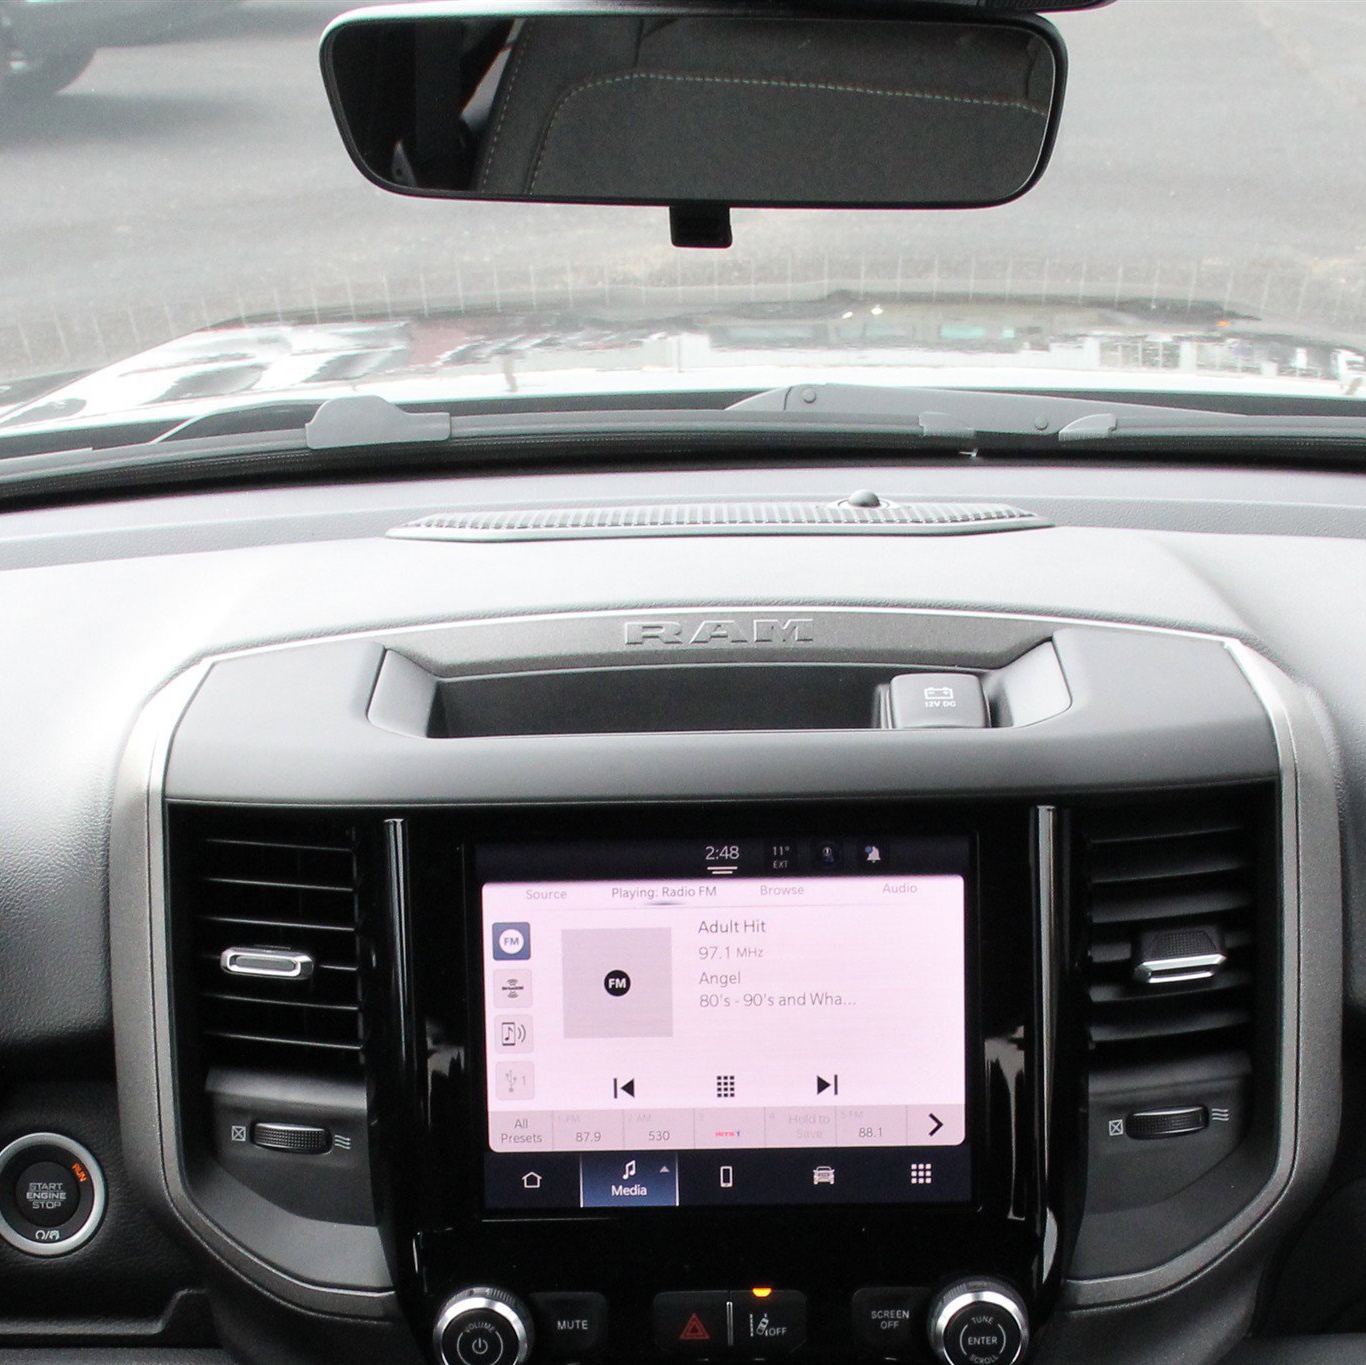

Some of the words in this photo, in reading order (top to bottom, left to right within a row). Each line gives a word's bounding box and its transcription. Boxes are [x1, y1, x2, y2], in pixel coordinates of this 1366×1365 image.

[624, 618, 814, 644] RAM
[705, 845, 740, 860] 2:48
[773, 860, 788, 869] EXT
[526, 889, 567, 900] Source
[611, 887, 658, 900] Playing:
[662, 886, 695, 897] Radio
[699, 886, 717, 896] FM
[760, 885, 804, 896] Browse
[882, 882, 918, 894] Audio
[697, 920, 739, 934] Adult
[744, 919, 766, 933] Hit
[503, 937, 519, 946] FM
[698, 946, 731, 960] 97.1
[736, 947, 764, 958] MHz
[608, 978, 627, 989] FM
[699, 971, 741, 988] Angel
[699, 994, 731, 1007] 80's
[743, 993, 775, 1007] 90's
[779, 992, 806, 1006] and
[514, 1119, 528, 1129] All
[500, 1132, 542, 1144] Presets
[576, 1131, 602, 1142] 87.9
[648, 1130, 670, 1141] 530
[858, 1127, 883, 1138] 88.1
[71, 1162, 87, 1183] RUN
[28, 1182, 63, 1191] START
[611, 1184, 648, 1196] Media
[26, 1192, 67, 1200] ENGINE
[32, 1201, 62, 1209] STOP
[871, 1310, 910, 1319] SCREEN
[557, 1320, 588, 1330] MUTE
[881, 1321, 899, 1330] OFF
[972, 1316, 994, 1325] TUNE
[464, 1321, 495, 1333] VOLUME
[769, 1327, 787, 1337] OFF
[968, 1336, 998, 1345] ENTER
[969, 1353, 999, 1365] SCROLL
